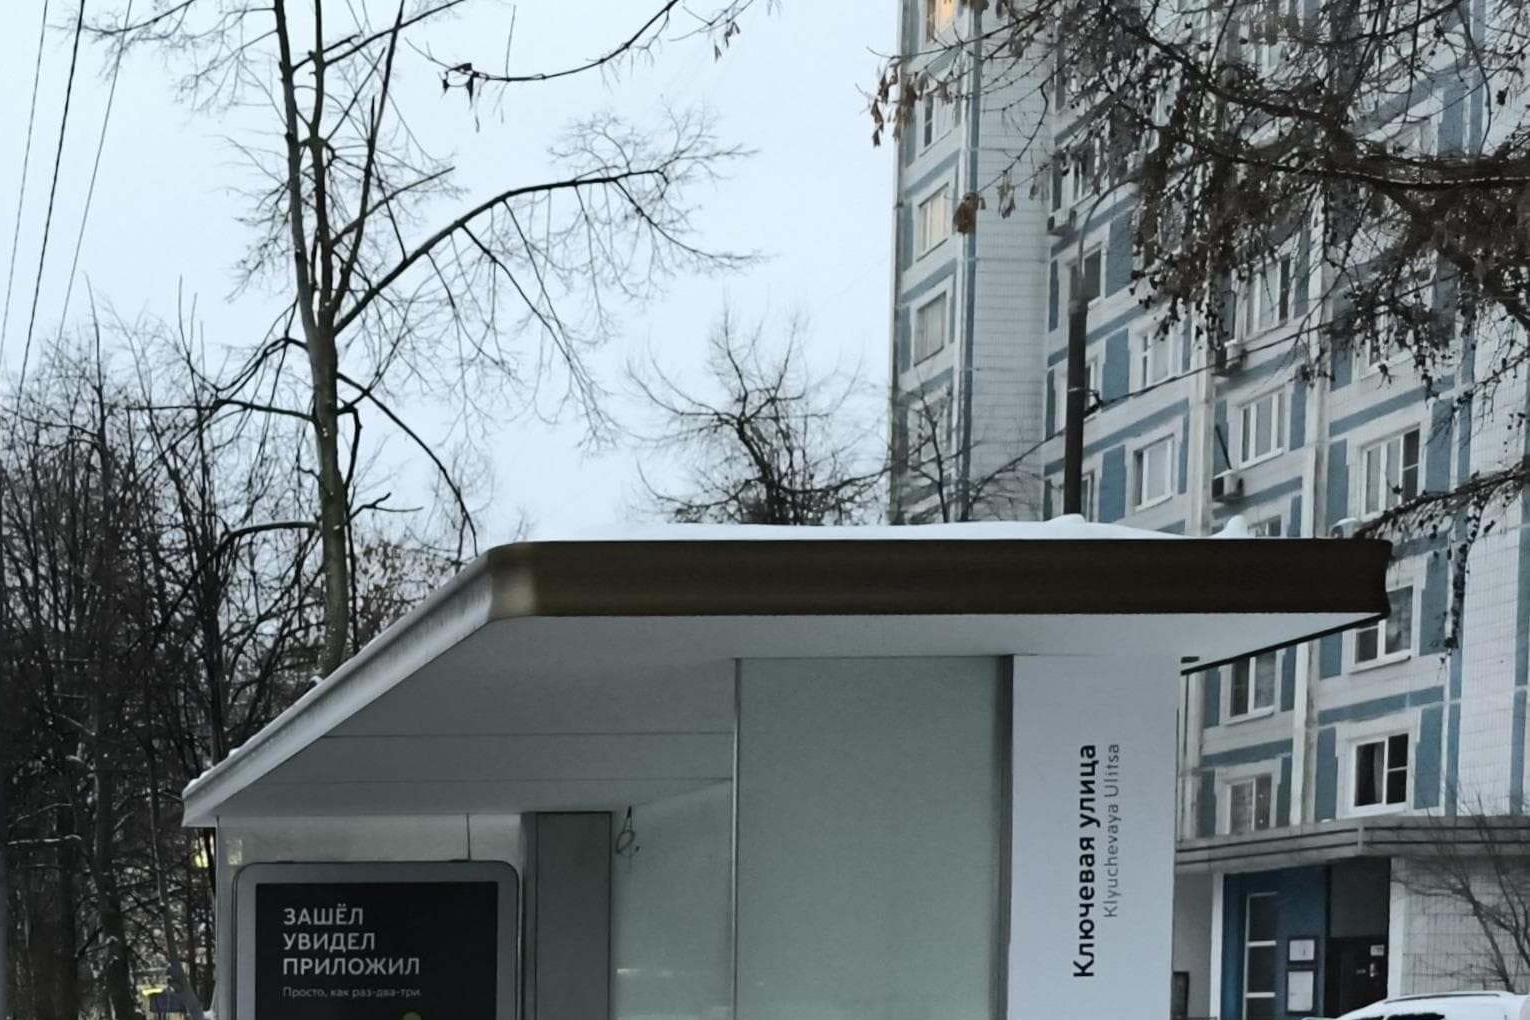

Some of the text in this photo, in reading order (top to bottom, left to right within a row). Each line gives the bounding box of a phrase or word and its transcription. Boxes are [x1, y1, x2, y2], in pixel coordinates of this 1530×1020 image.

[1103, 743, 1122, 918] Klyuchevaya Ulitsa
[1073, 744, 1101, 978] Ключевая улица
[283, 903, 364, 926] ЗАШЁЛ
[283, 932, 375, 953] УВИДЕЛ
[283, 957, 420, 976] ПРИЛОЖИЛ
[283, 987, 328, 998] Просто,
[330, 988, 349, 998] как
